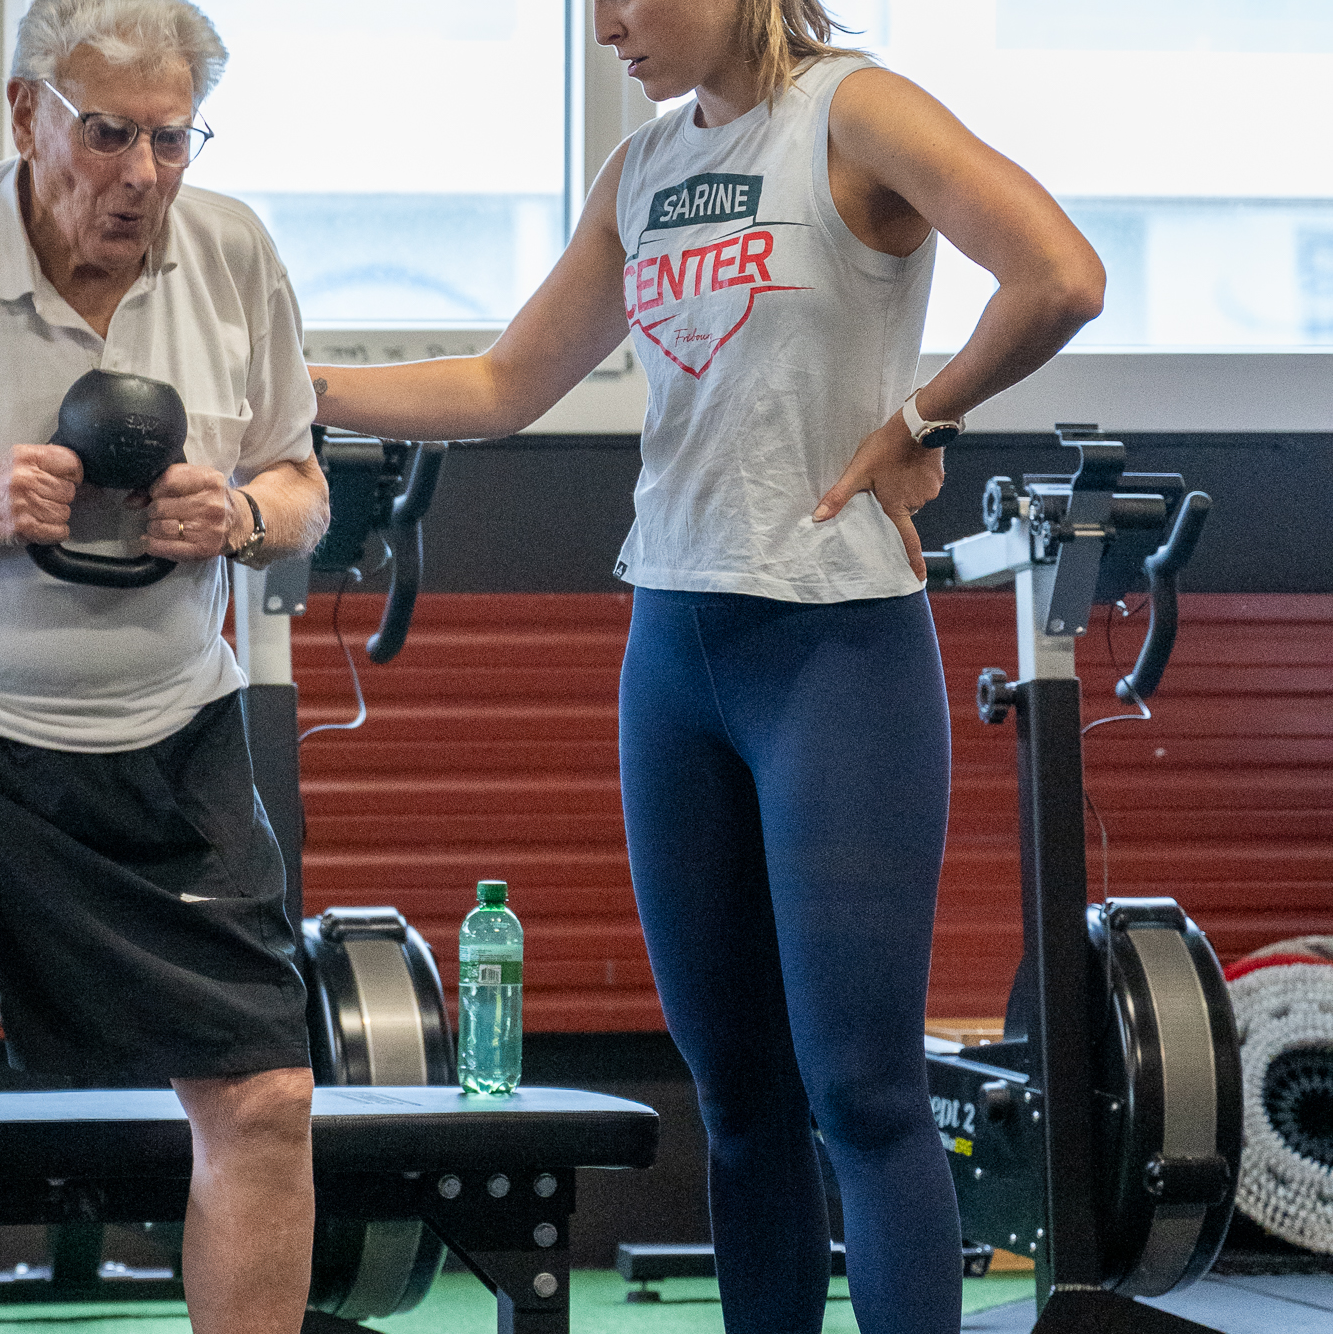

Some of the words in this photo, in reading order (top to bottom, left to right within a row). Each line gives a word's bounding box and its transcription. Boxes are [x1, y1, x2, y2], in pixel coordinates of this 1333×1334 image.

[659, 183, 750, 223] SARINE
[623, 230, 774, 321] CENTER
[963, 1102, 976, 1134] 2
